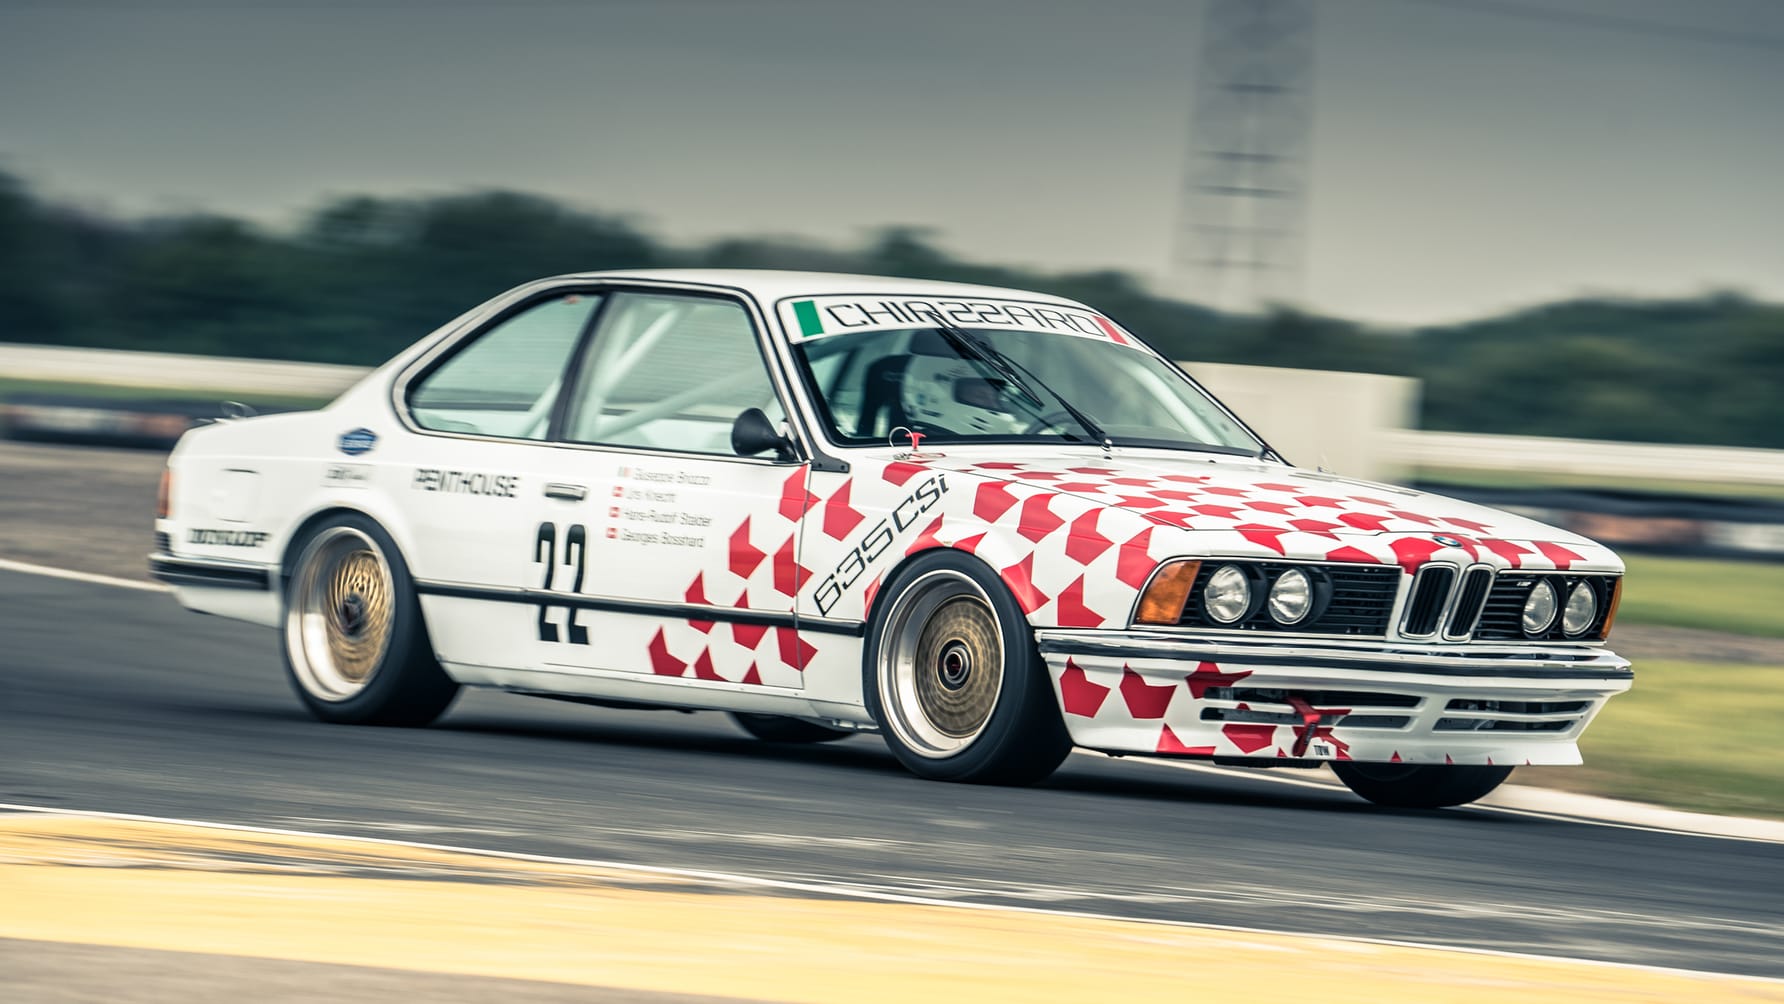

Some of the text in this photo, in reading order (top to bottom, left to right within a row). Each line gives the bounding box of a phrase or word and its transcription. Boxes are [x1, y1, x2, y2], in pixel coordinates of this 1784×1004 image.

[824, 300, 1107, 338] CHIAZZARO
[413, 468, 520, 498] PENTHOUSE
[535, 521, 590, 645] 22
